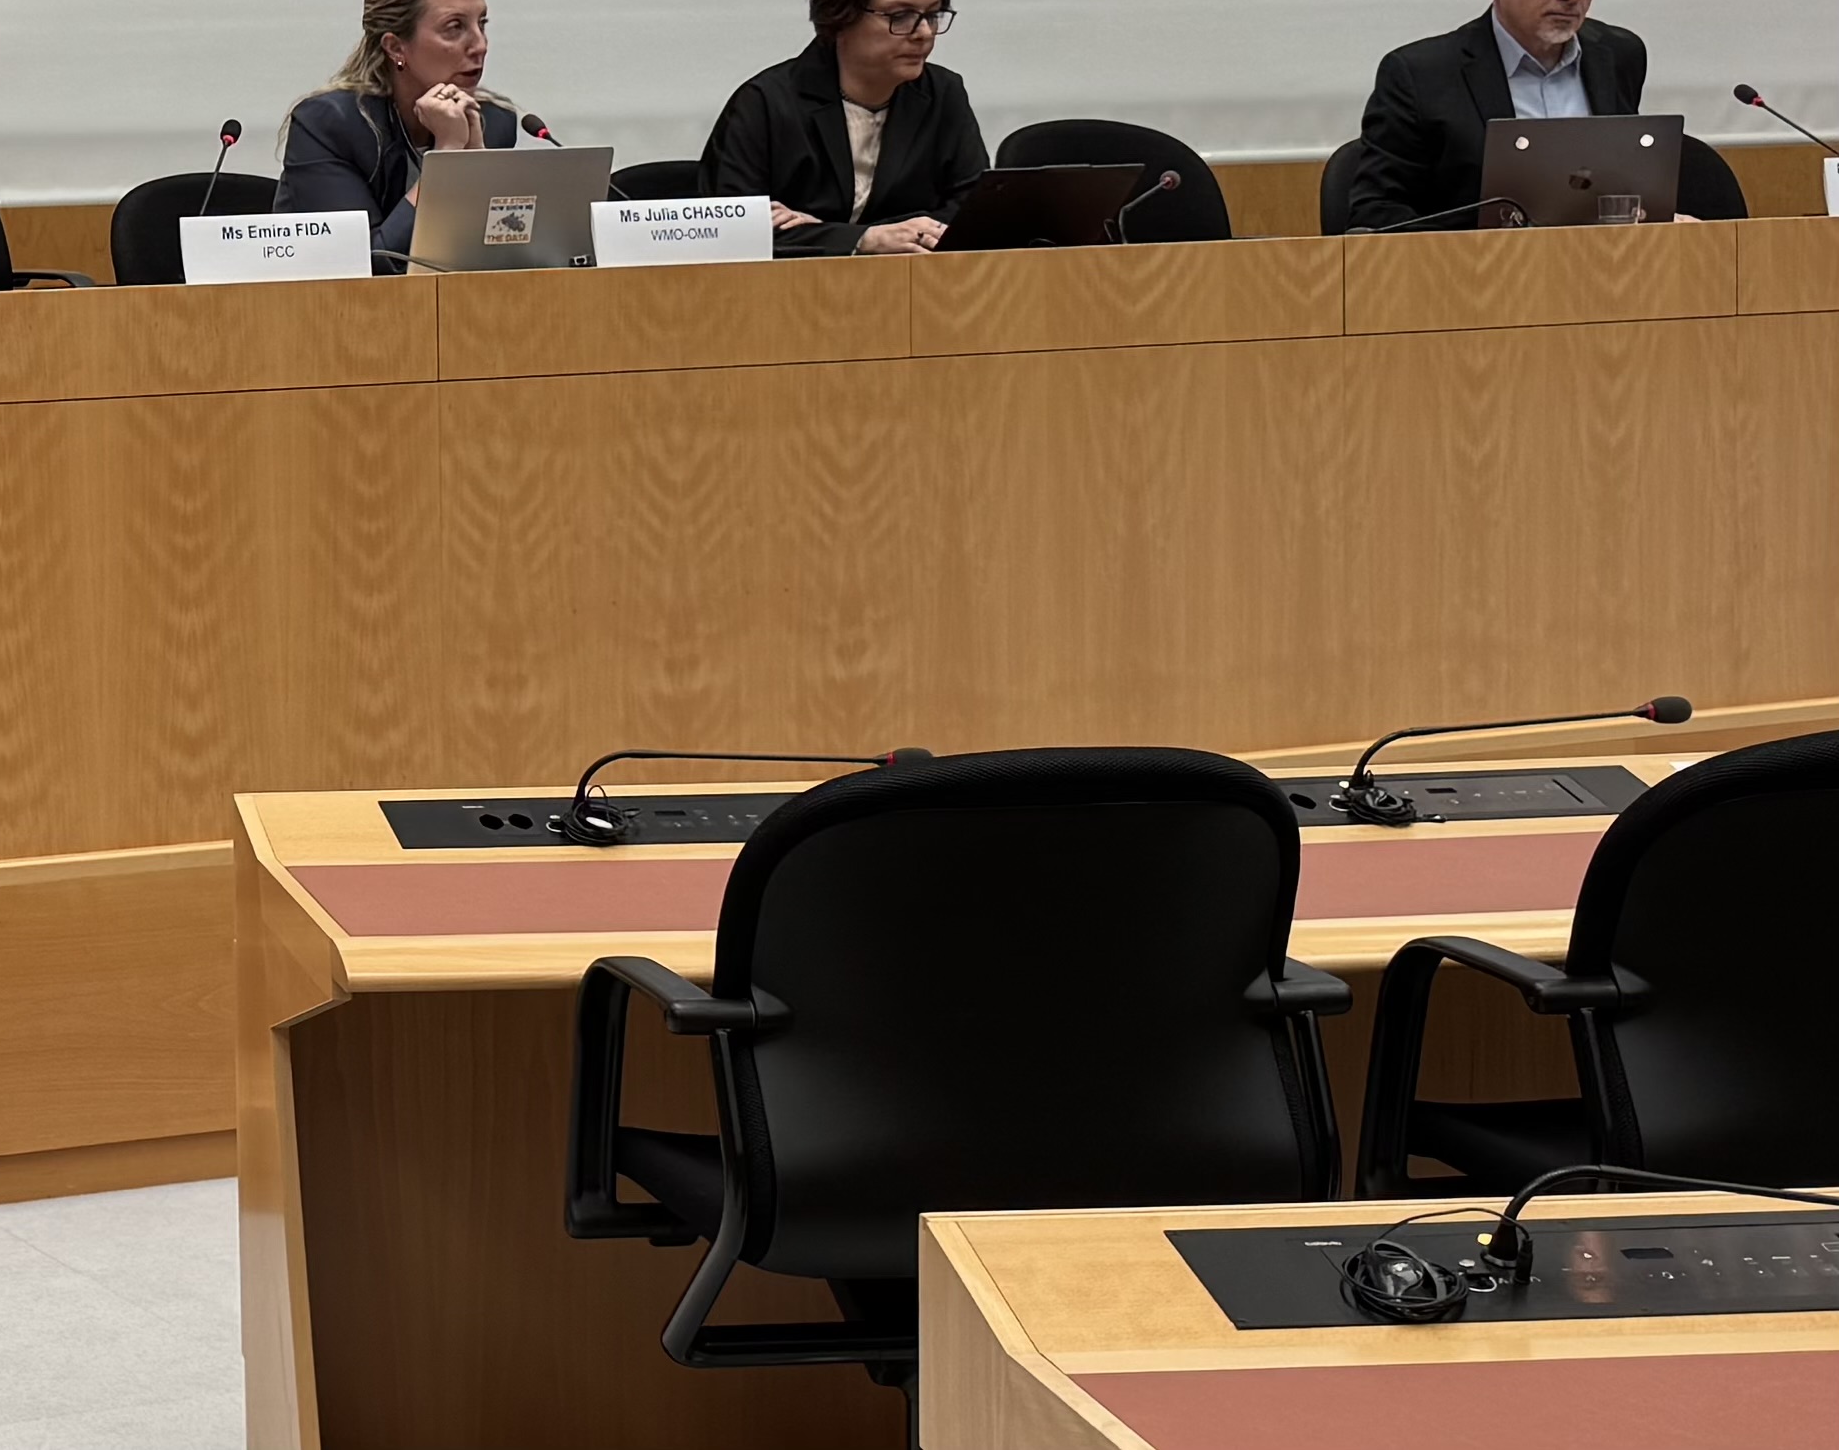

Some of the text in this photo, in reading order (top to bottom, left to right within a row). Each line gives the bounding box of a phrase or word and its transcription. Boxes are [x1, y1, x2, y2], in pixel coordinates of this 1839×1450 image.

[619, 205, 746, 223] Ms Julia CHASCO
[221, 221, 332, 240] Ms Emira FIDA
[650, 227, 719, 242] WMO-OMM
[262, 245, 295, 259] IPCC
